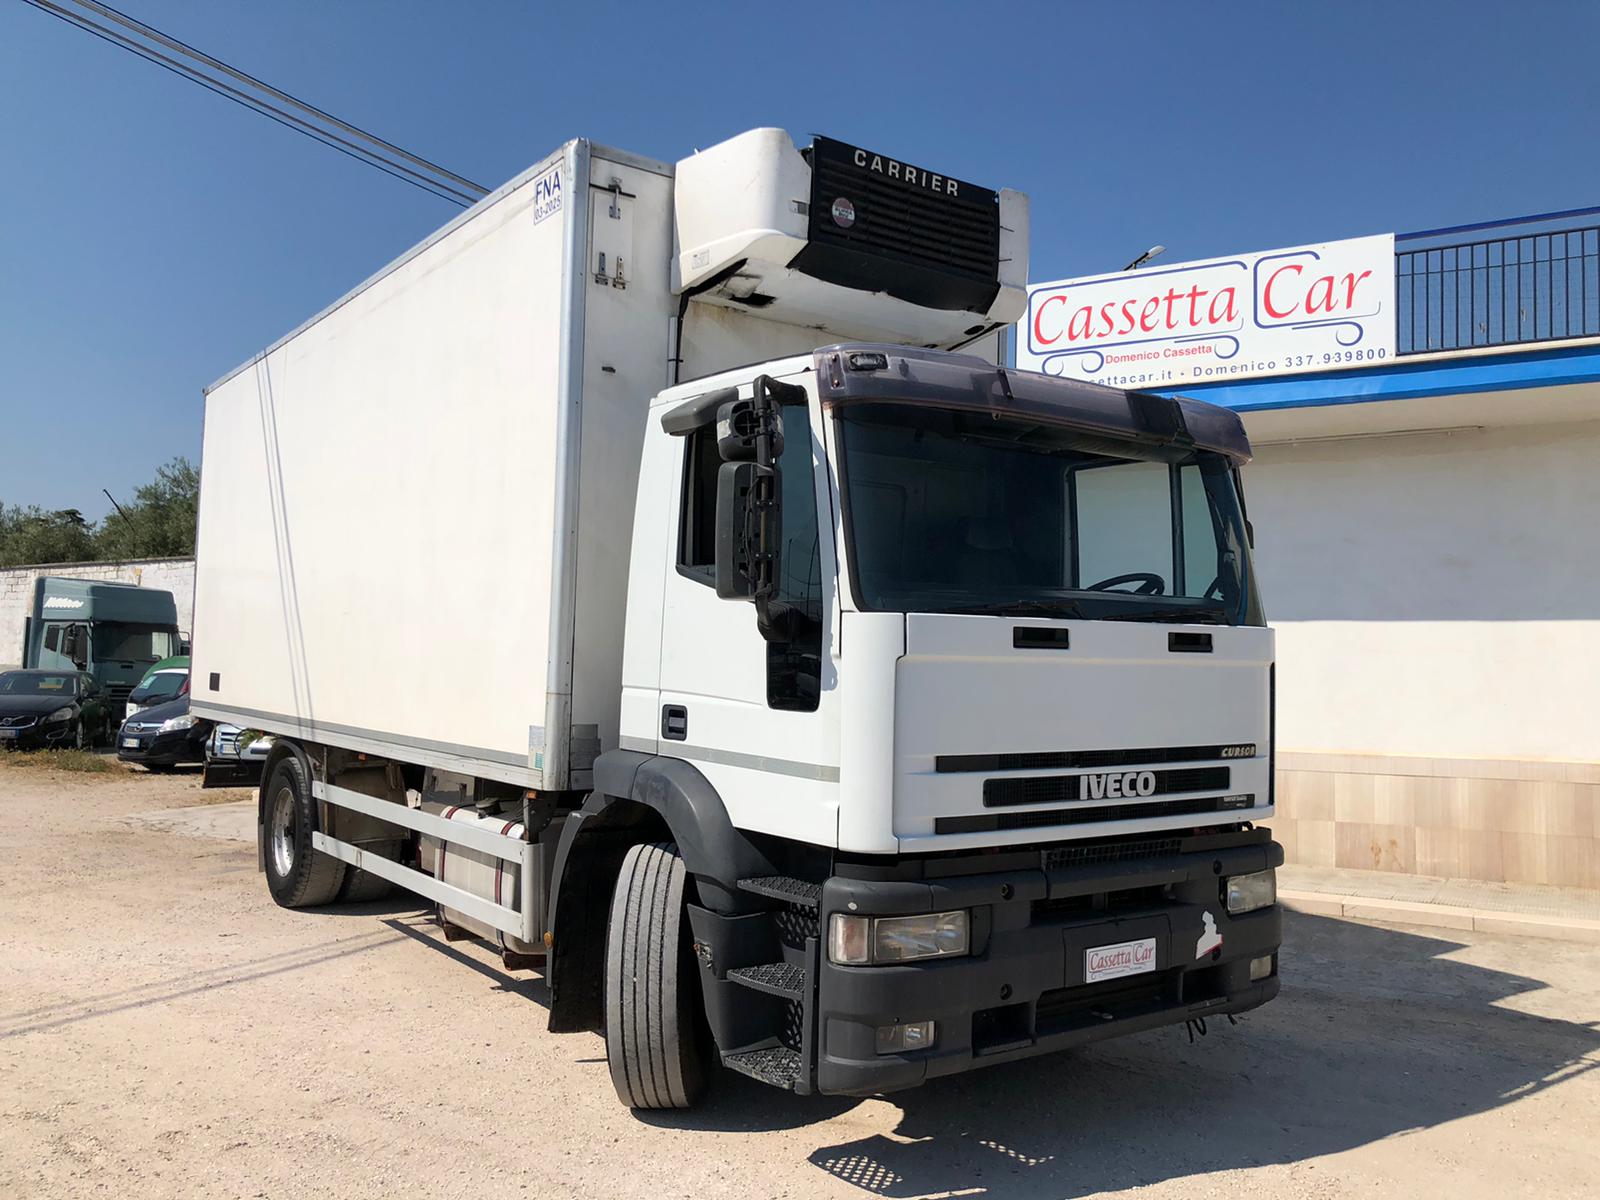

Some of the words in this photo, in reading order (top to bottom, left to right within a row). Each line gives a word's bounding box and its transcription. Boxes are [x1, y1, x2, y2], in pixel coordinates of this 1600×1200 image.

[853, 149, 960, 197] CARRIER
[535, 170, 561, 206] FNA
[1033, 283, 1239, 346] Cassetta
[1263, 264, 1373, 320] Car
[1105, 350, 1160, 365] Domenico
[1163, 345, 1213, 358] Cassetta
[1193, 360, 1276, 377] Domenico
[1284, 347, 1387, 368] 337.939800
[1221, 746, 1256, 758] CURSOR
[1079, 771, 1156, 800] IVECO
[1090, 951, 1132, 970] Cassetta
[1134, 944, 1154, 963] Car
